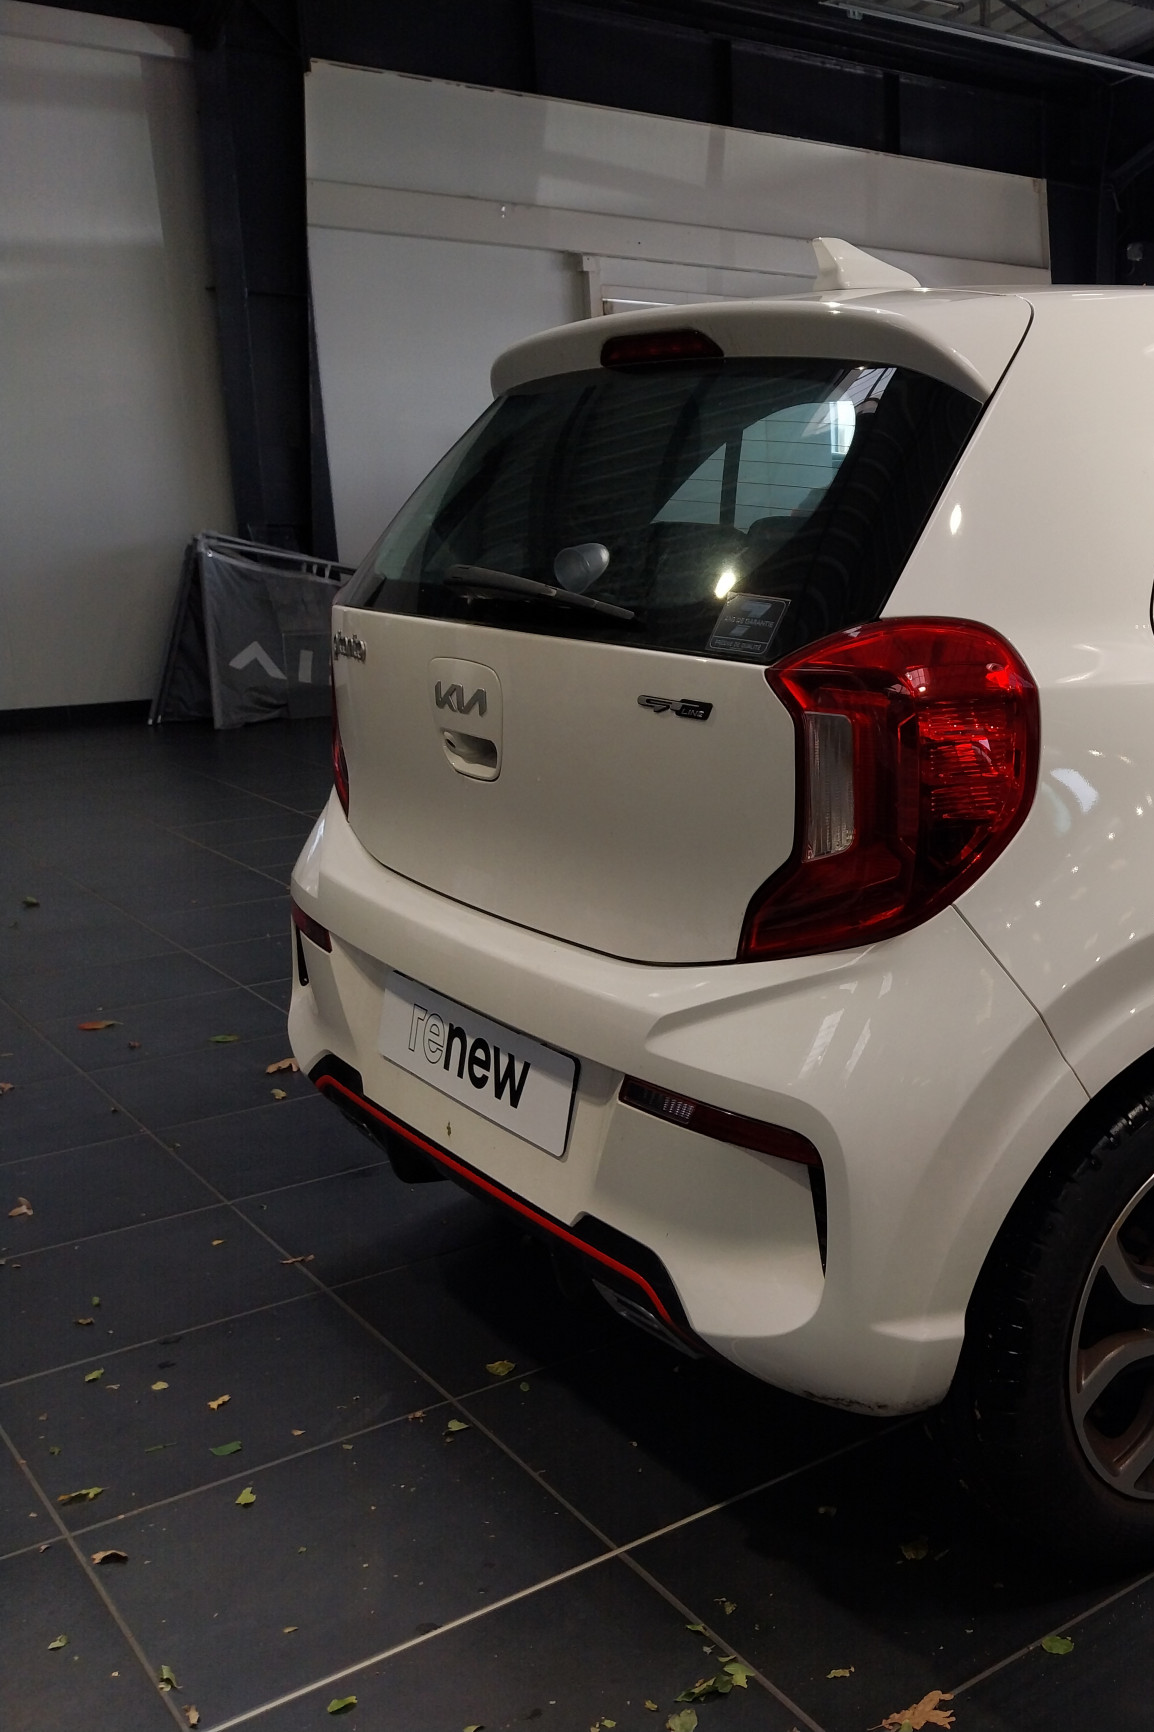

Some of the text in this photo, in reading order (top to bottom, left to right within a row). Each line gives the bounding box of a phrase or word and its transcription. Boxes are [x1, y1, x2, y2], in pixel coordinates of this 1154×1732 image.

[744, 618, 775, 629] GARANTIE
[434, 680, 487, 719] KIA
[408, 1003, 531, 1110] renew
